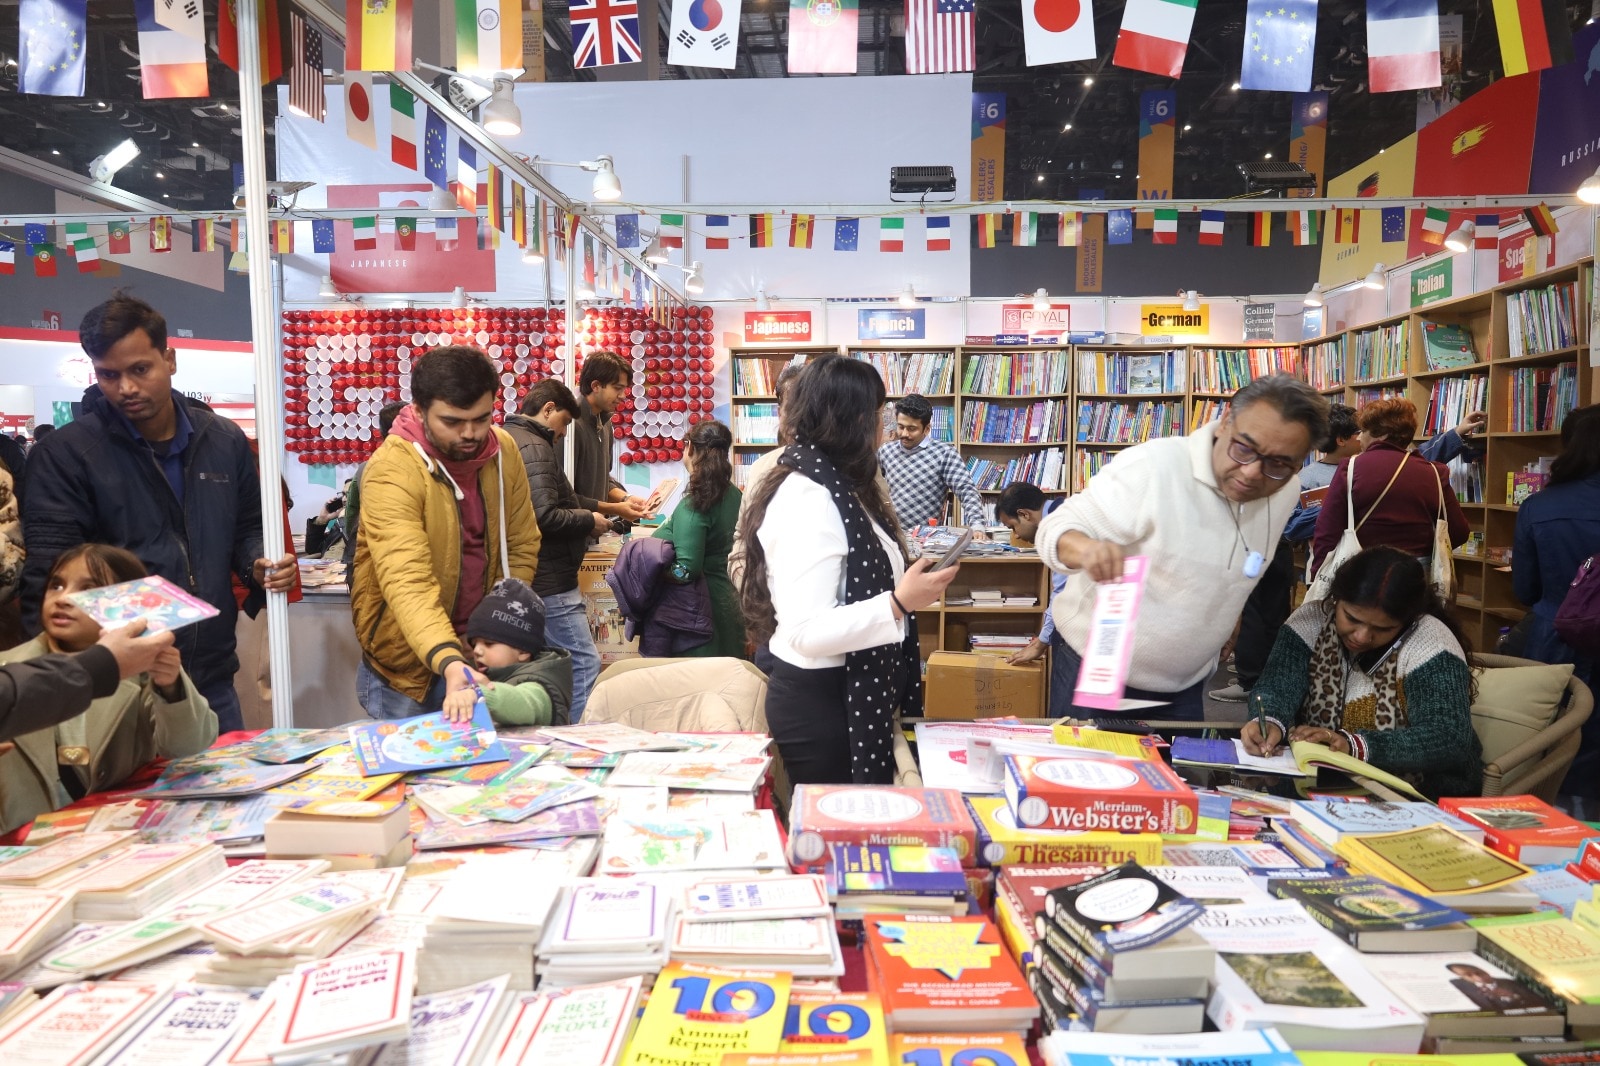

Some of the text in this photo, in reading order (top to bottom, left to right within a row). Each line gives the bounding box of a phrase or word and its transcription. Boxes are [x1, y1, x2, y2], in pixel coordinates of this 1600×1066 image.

[986, 102, 999, 119] 6
[1155, 99, 1168, 116] 6
[976, 157, 986, 200] KSELLERS/
[986, 159, 995, 200] LESALERS
[350, 259, 408, 269] JAPANESE
[1417, 273, 1445, 296] Italian
[1022, 310, 1066, 323] GOYAL
[1245, 307, 1274, 315] Collins
[1148, 312, 1202, 328] German
[1245, 317, 1274, 325] German
[752, 319, 809, 336] Japanese
[305, 333, 685, 441] GYL
[491, 609, 533, 632] PORSCHE
[1093, 800, 1147, 813] Merriam-
[1050, 806, 1159, 830] Webster's
[869, 833, 924, 845] Merriam-
[1041, 842, 1112, 851] Merriam-Webster's
[1013, 843, 1137, 865] Thesaurus
[1406, 853, 1482, 872] Spelling
[1008, 865, 1104, 877] Handbook
[743, 969, 776, 979] Series
[669, 976, 776, 1020] 10
[563, 1000, 607, 1013] BEST
[163, 1019, 230, 1030] SPEECH
[541, 1017, 612, 1034] PEOPLE
[676, 1026, 749, 1039] Annual
[668, 1037, 748, 1051] Reports
[903, 1036, 1004, 1045] Best-Selling Series
[820, 1052, 858, 1062] Series
